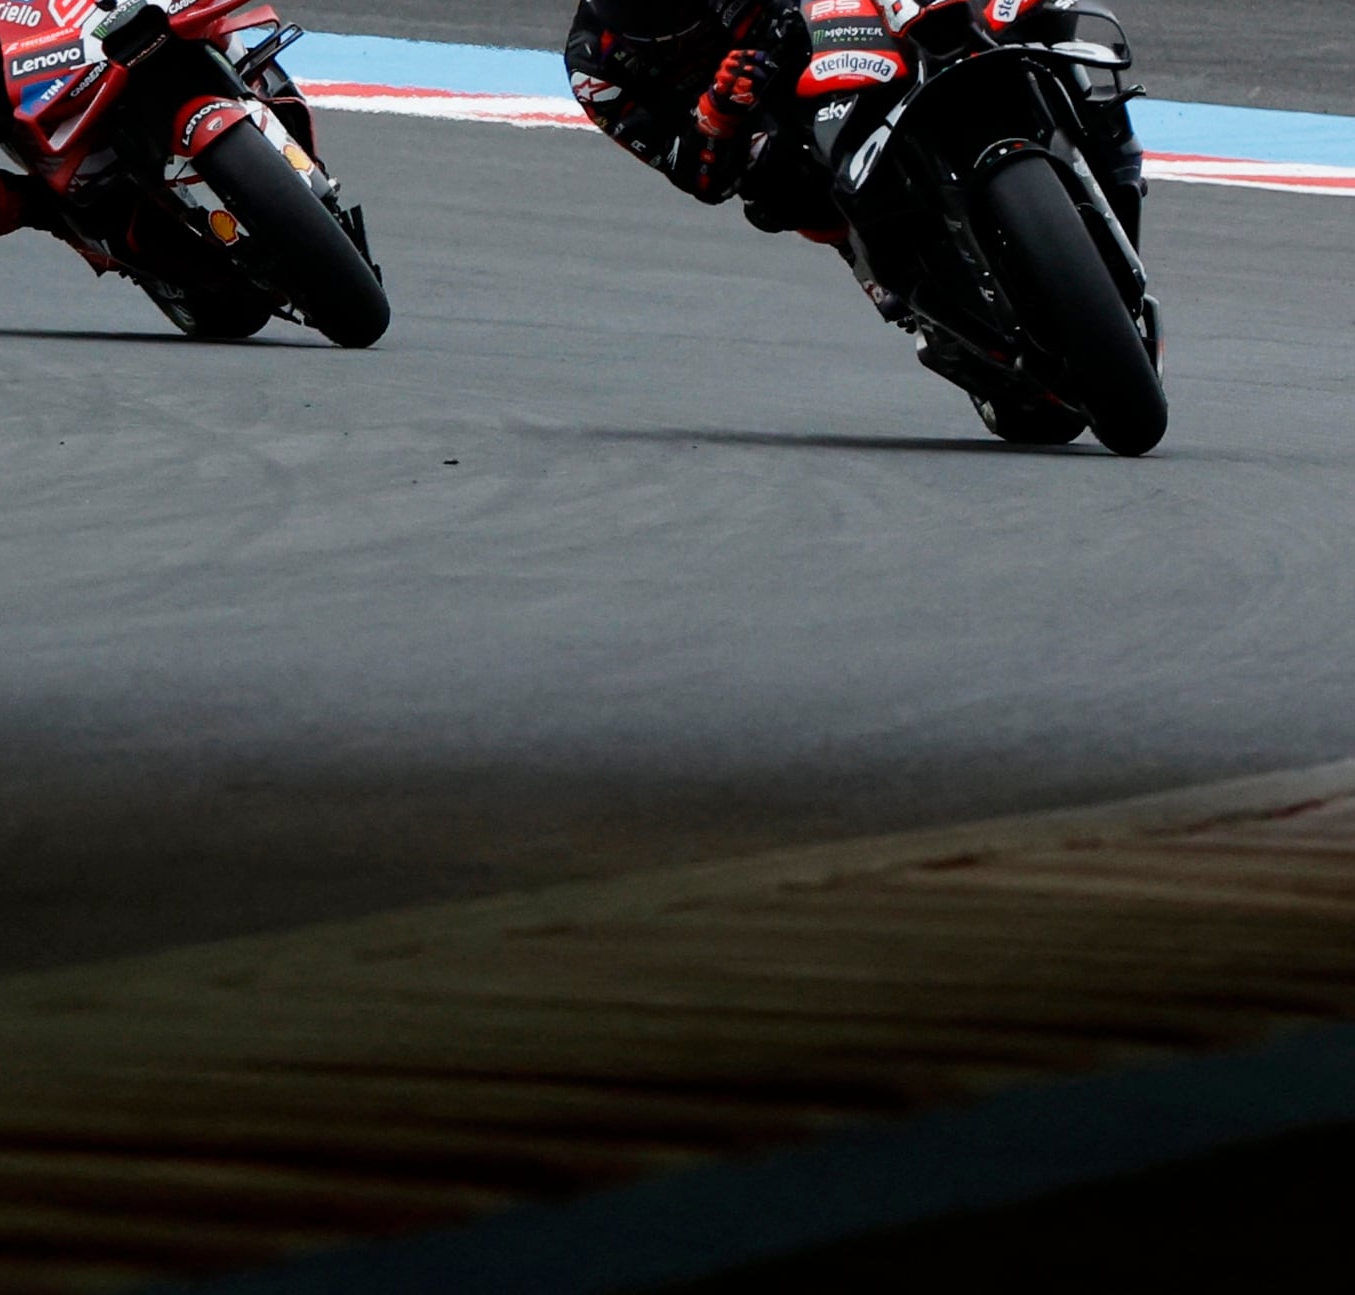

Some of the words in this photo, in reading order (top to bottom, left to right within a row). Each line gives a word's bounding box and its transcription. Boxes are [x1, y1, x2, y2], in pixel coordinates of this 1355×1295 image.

[825, 25, 883, 38] MONSTER
[11, 47, 81, 76] Lenovo
[815, 53, 891, 77] sterilgarda
[41, 79, 65, 101] TIM
[70, 61, 108, 97] CARRERA
[182, 101, 233, 146] Lenovo
[817, 101, 853, 122] sky
